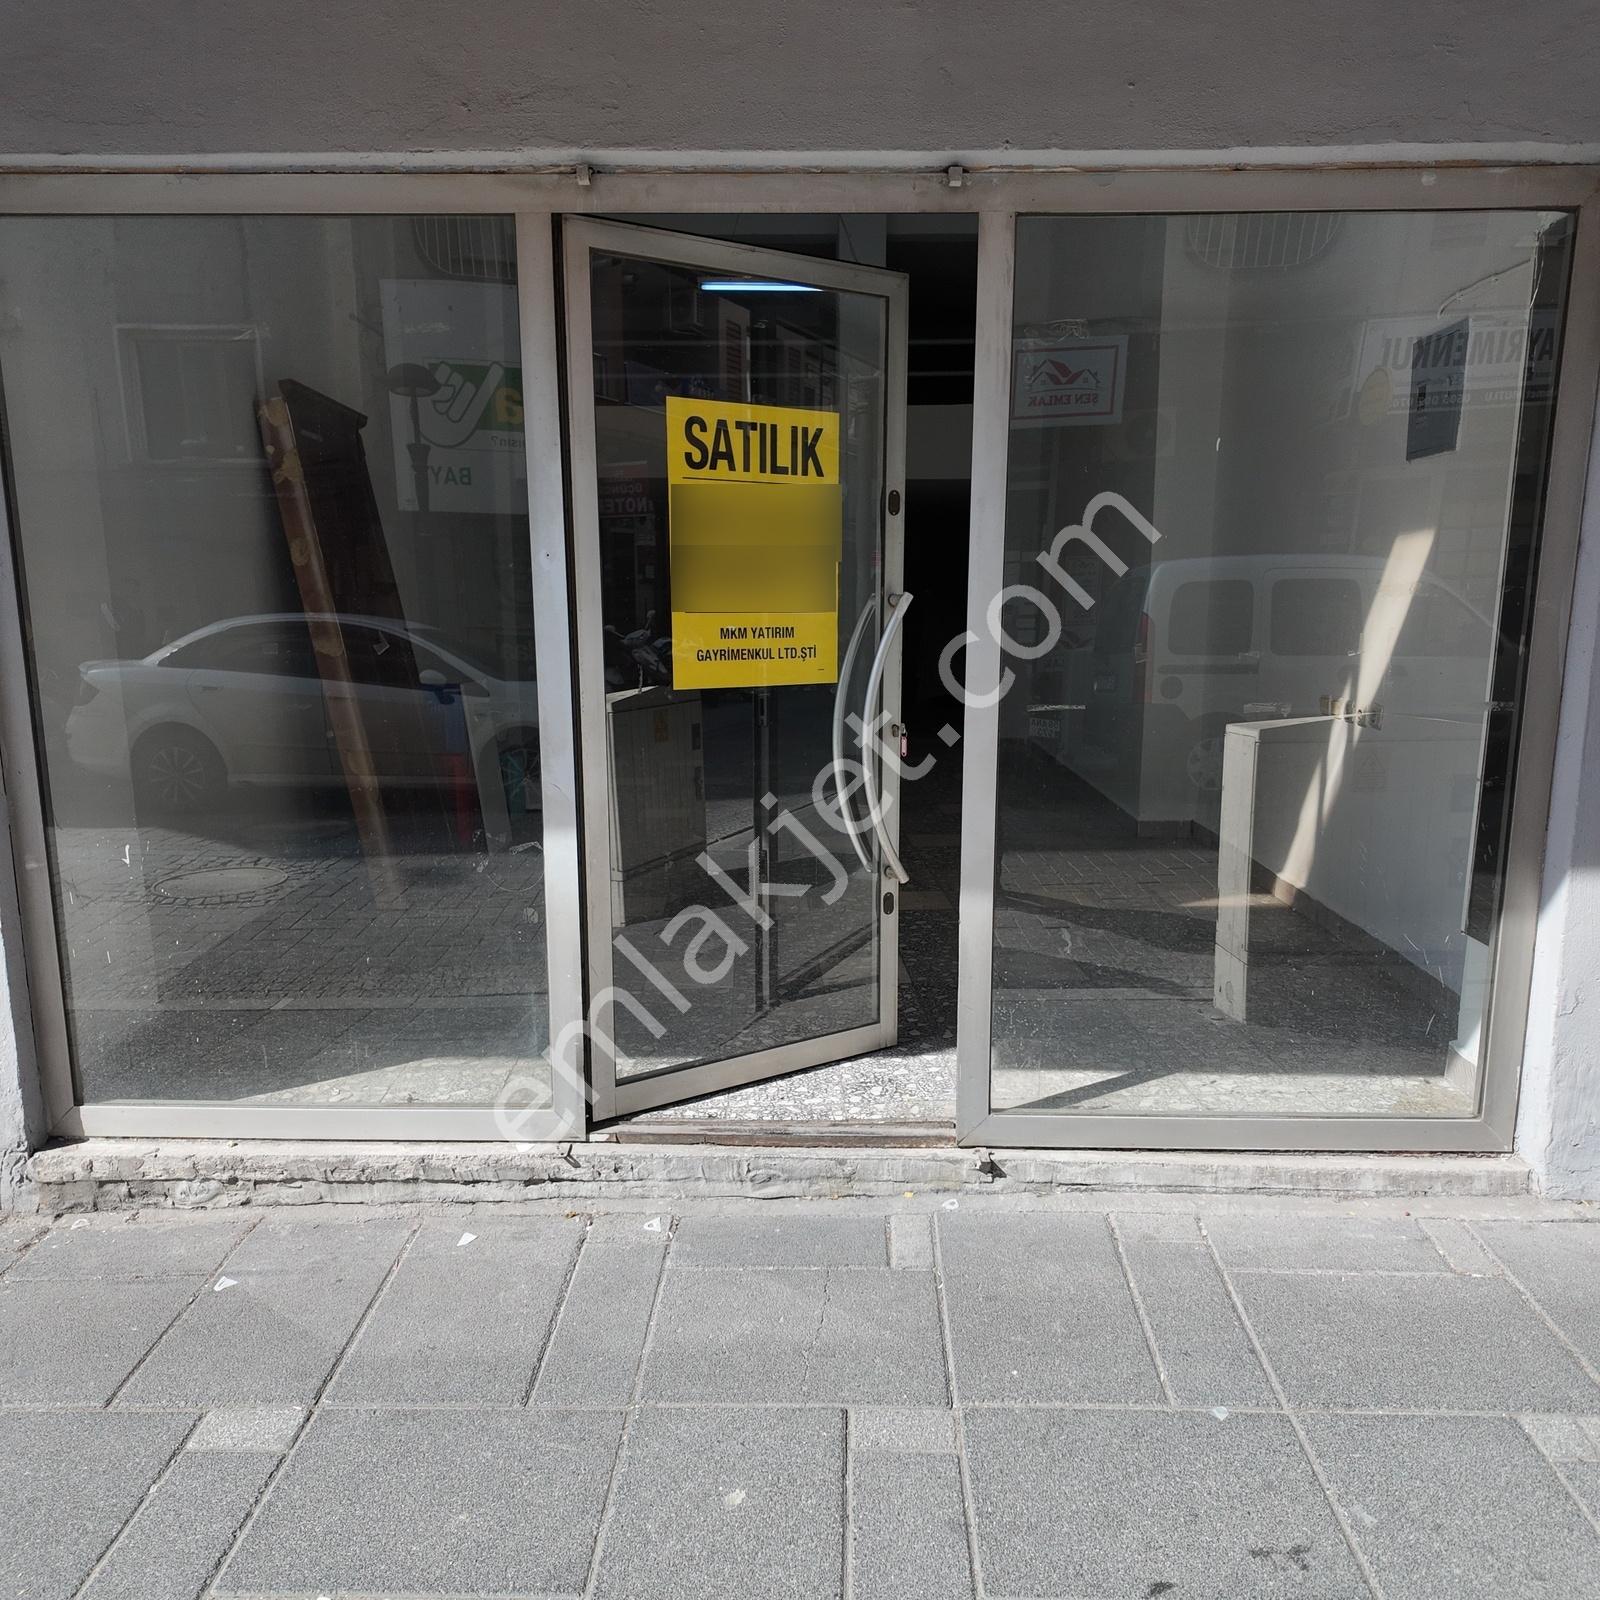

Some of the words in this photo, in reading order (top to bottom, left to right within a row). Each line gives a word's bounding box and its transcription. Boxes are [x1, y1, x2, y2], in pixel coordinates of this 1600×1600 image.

[684, 415, 824, 478] SATILIK
[720, 626, 748, 640] MKM
[751, 625, 795, 640] YATIRIM
[696, 645, 776, 662] GAYRİMENKUL
[777, 643, 817, 662] LTD.ŞTİ
